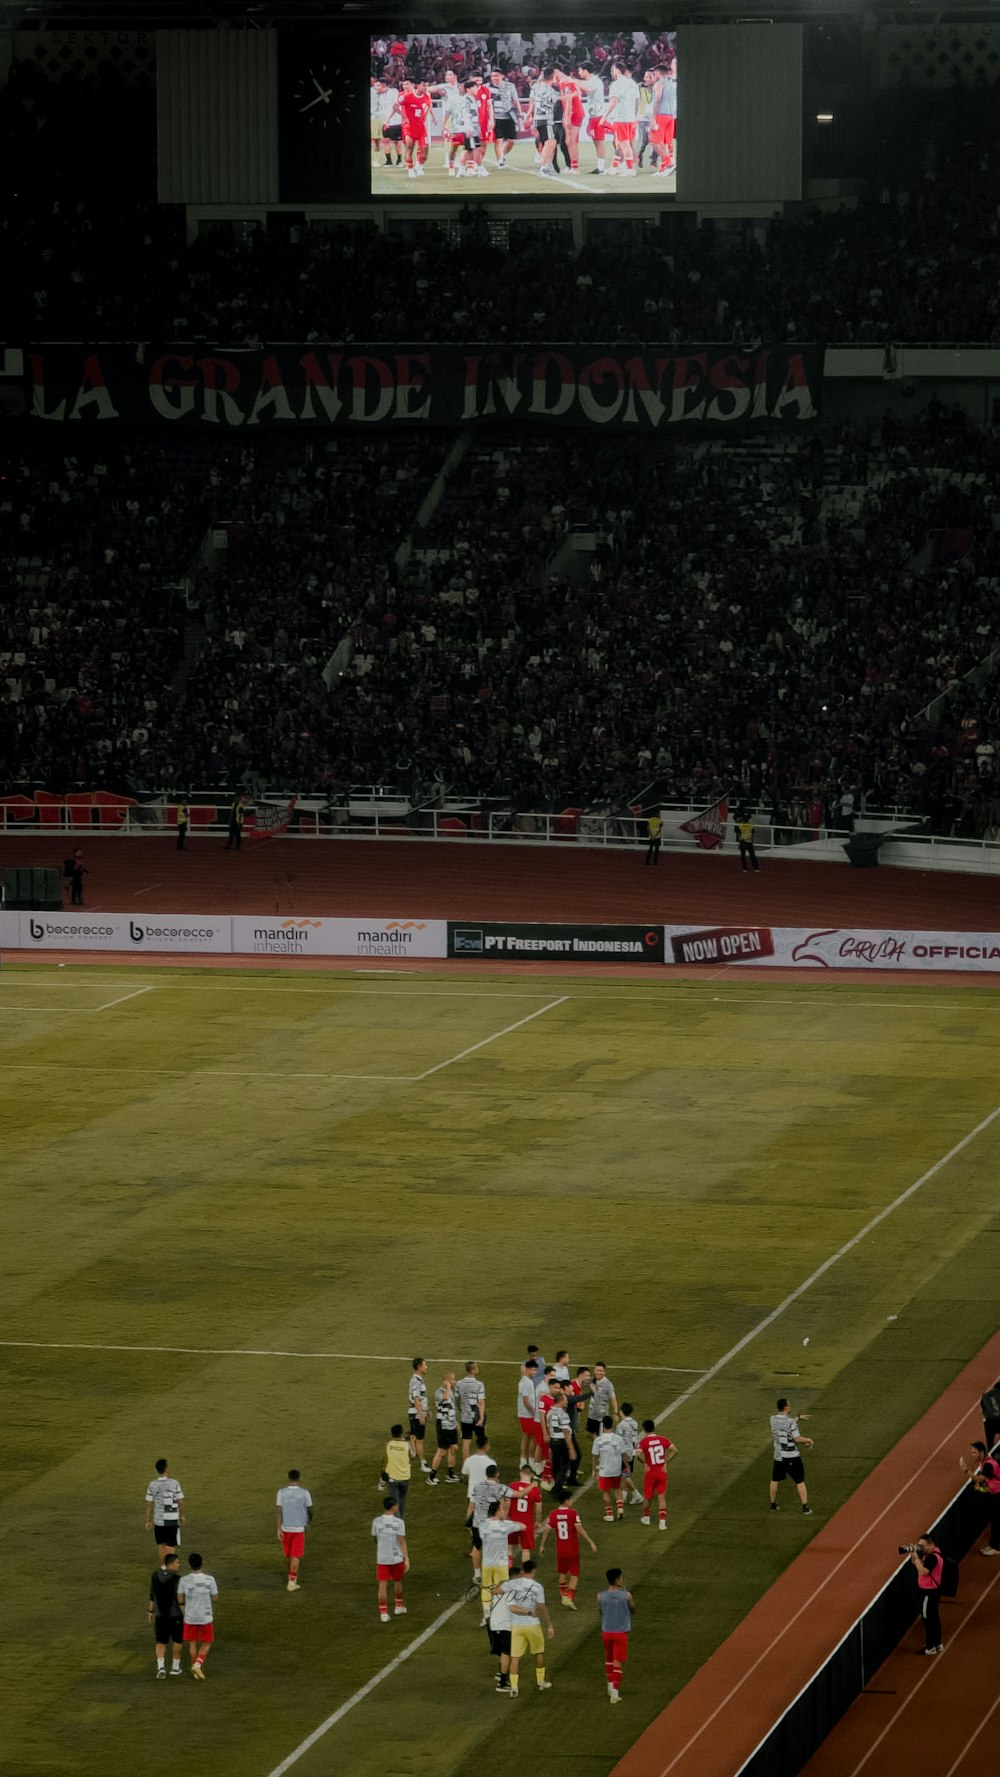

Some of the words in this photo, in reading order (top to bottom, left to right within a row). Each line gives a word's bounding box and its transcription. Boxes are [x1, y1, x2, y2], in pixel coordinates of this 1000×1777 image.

[29, 353, 120, 421] LA
[148, 352, 432, 426] GRANDE
[460, 352, 818, 427] INDONESIA
[46, 924, 114, 935] bocorocco
[146, 926, 214, 938] bocorocco
[254, 927, 308, 940] mandiri
[357, 930, 412, 942] mandiri
[254, 940, 303, 953] inhealth
[357, 943, 407, 955] inhealth
[485, 936, 506, 950] PT
[682, 938, 718, 962] NOW
[720, 931, 762, 956] OPEN
[839, 937, 906, 962] GARUDA
[648, 1445, 665, 1466] 12
[557, 1520, 569, 1540] 8
